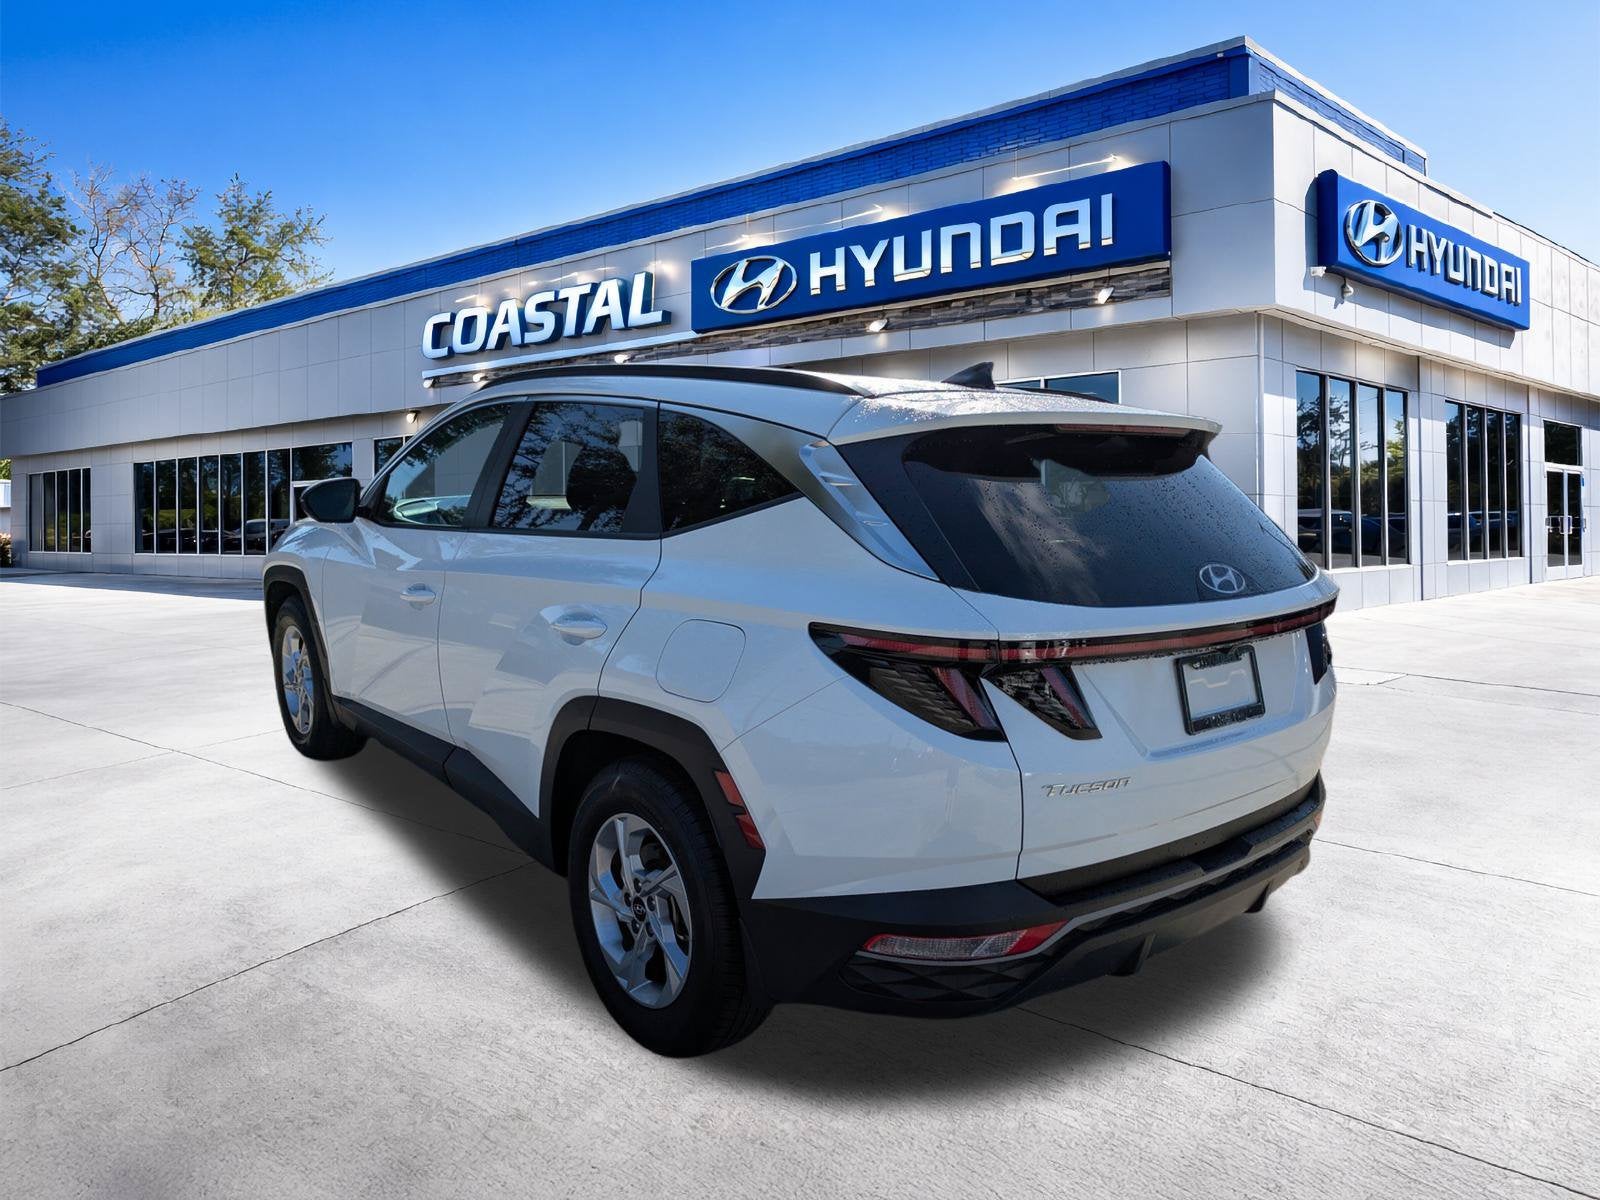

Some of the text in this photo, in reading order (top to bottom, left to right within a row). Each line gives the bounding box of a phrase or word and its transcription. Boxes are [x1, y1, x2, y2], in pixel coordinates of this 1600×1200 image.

[809, 193, 1113, 295] HYUNDAI
[1406, 224, 1522, 305] HYUNDAI
[422, 271, 671, 359] COASTAL
